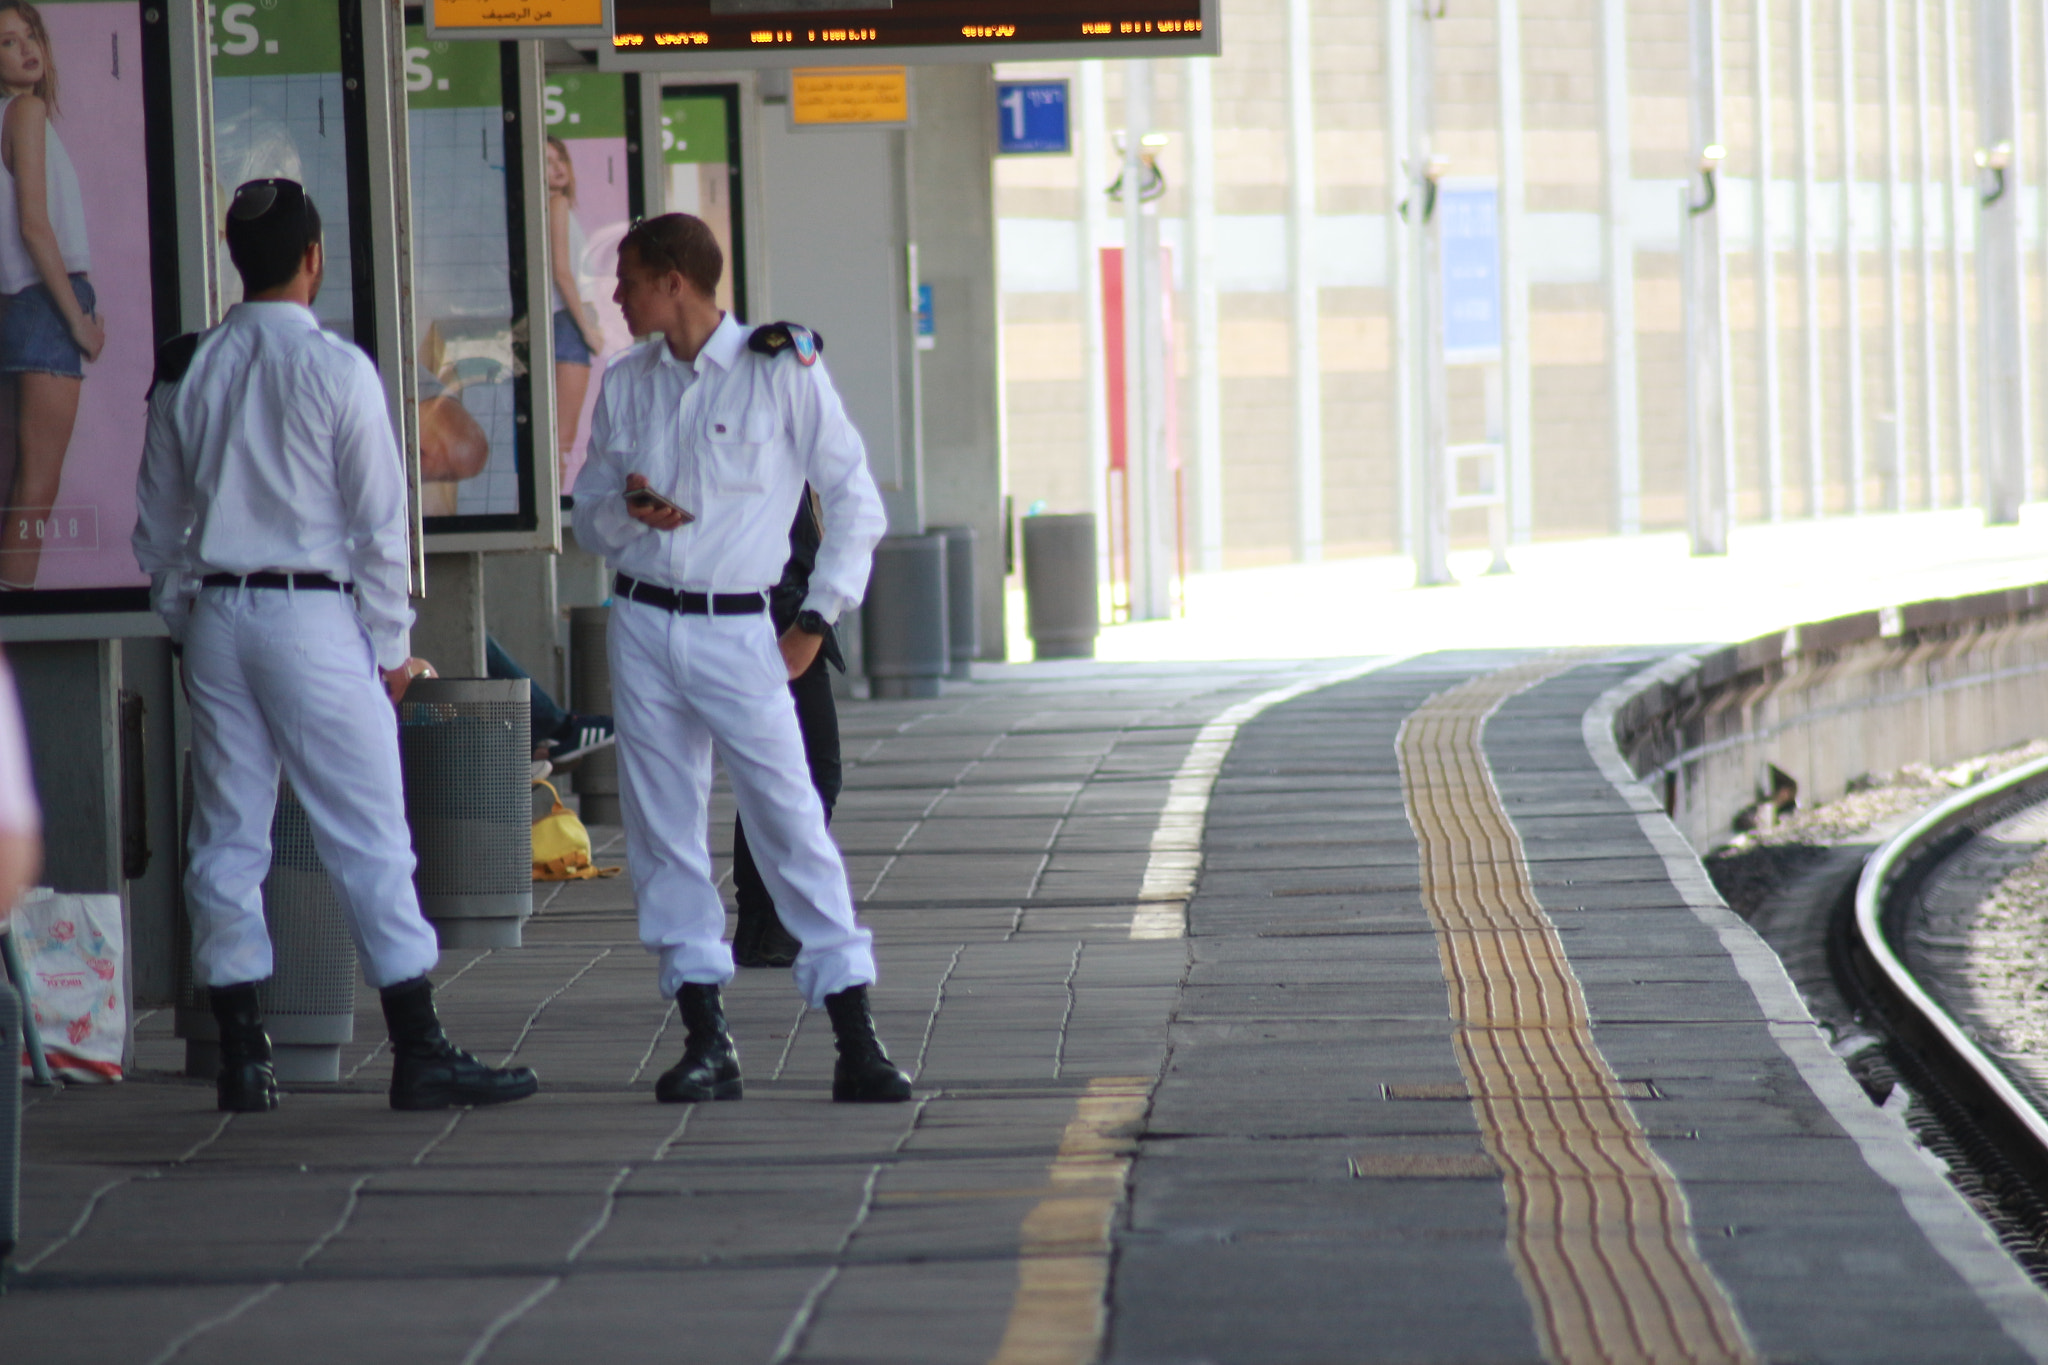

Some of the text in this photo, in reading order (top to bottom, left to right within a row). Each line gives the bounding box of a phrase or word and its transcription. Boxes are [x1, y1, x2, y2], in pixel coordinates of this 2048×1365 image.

[481, 8, 553, 22] من الرصيف
[1002, 90, 1025, 139] 1
[19, 519, 77, 539] 2018
